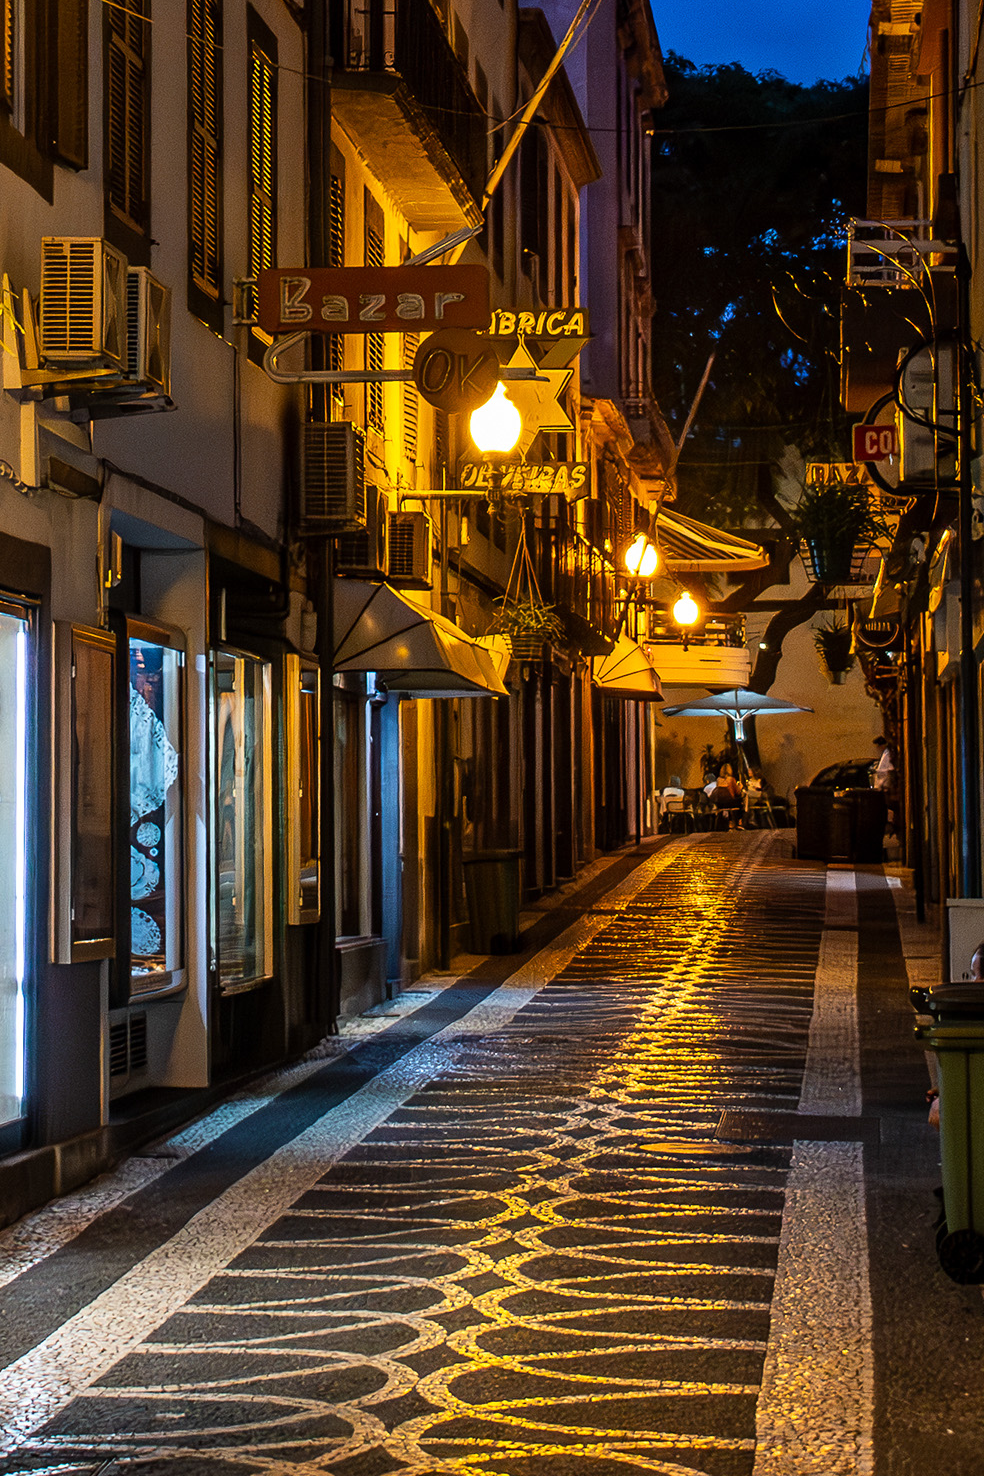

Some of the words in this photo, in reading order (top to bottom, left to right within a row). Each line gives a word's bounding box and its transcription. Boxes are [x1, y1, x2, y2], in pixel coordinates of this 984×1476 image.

[280, 276, 465, 323] Bazar
[422, 349, 485, 393] OK
[460, 463, 587, 490] OLVEIRAS
